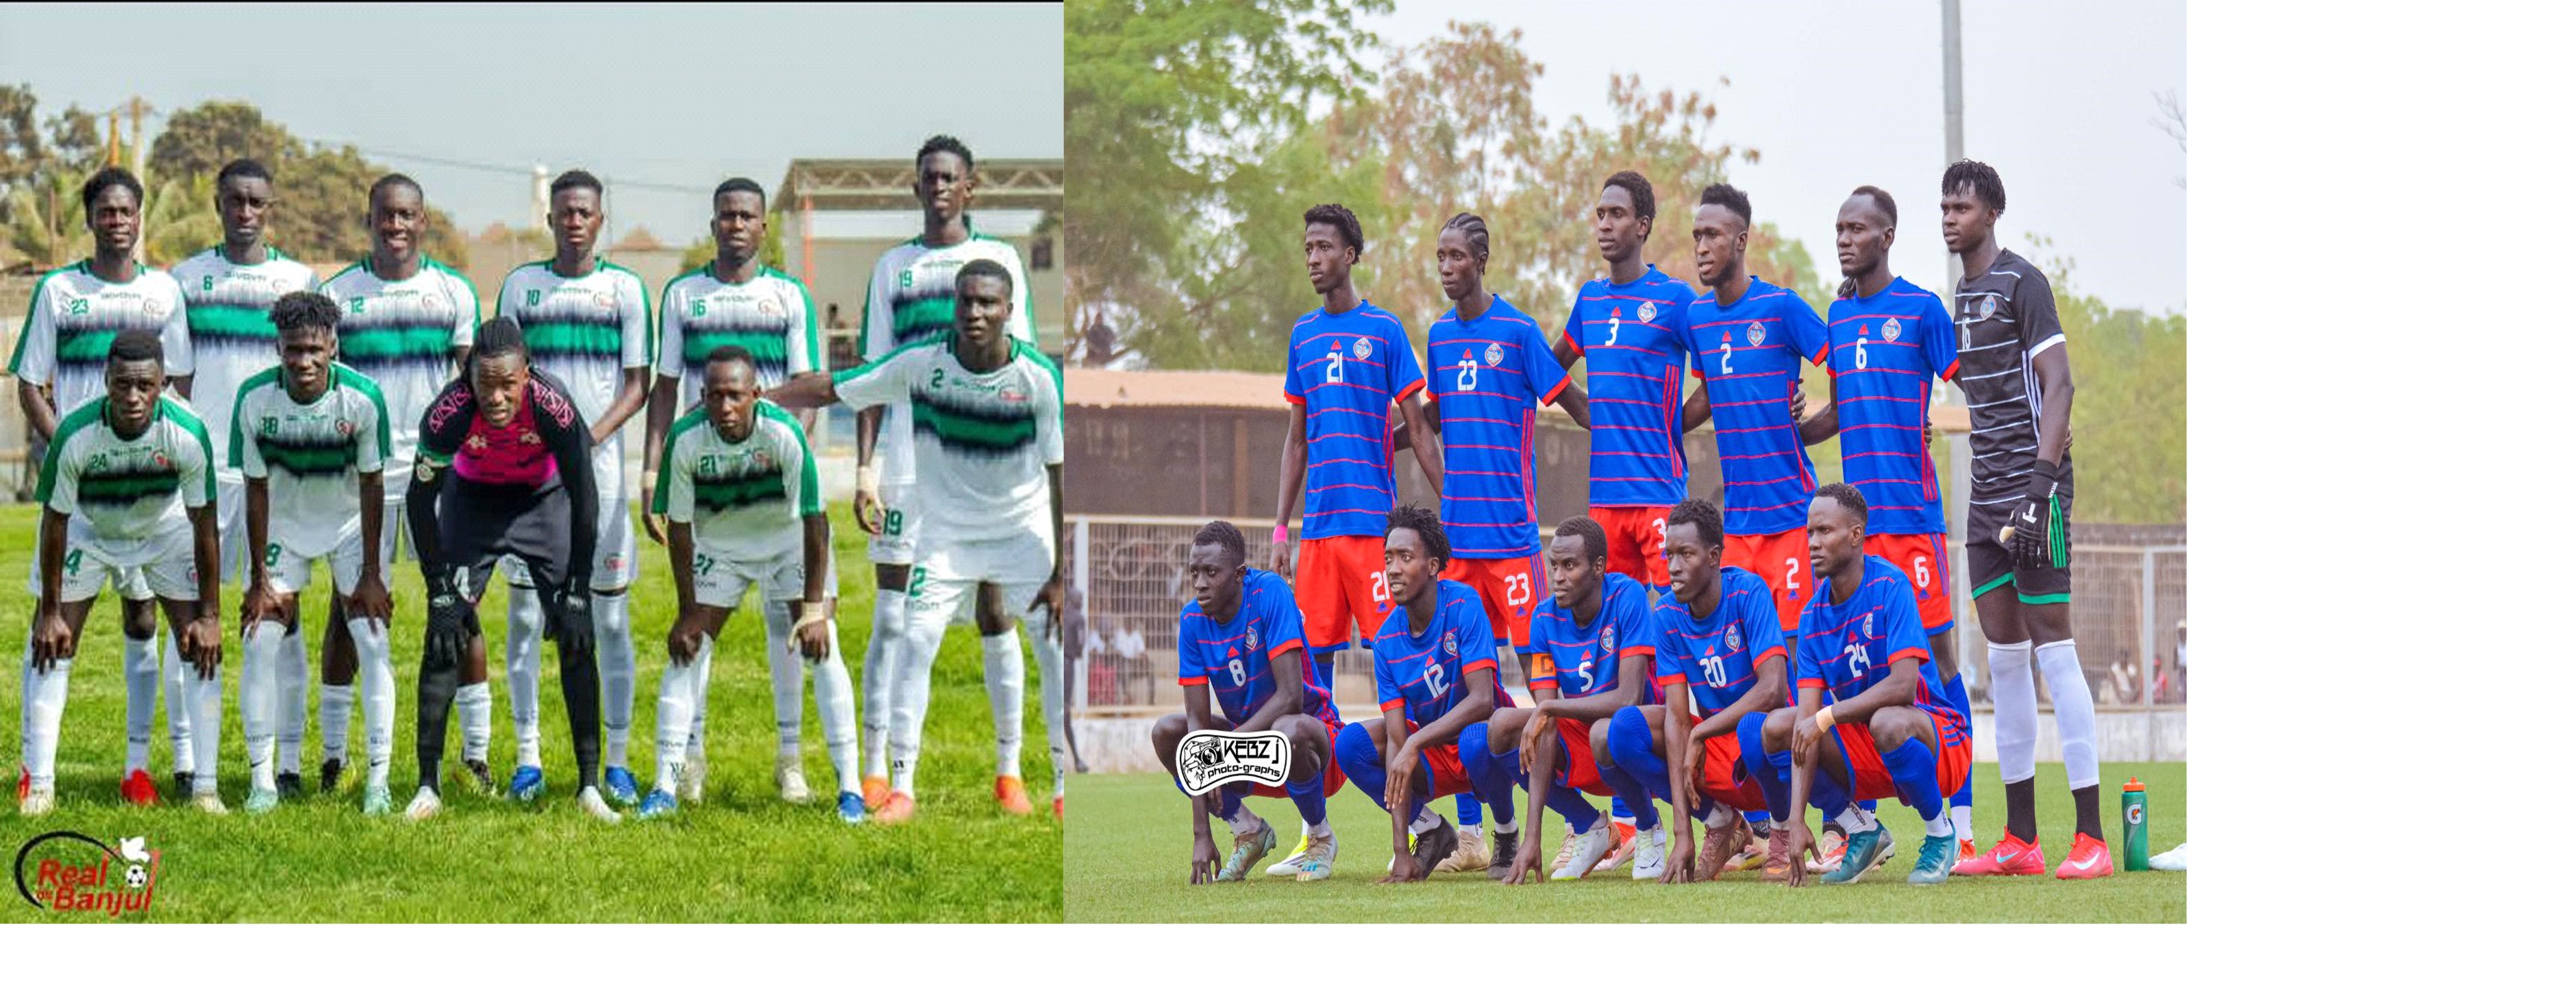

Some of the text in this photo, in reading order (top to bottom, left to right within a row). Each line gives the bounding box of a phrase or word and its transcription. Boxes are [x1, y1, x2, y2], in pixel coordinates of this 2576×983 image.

[203, 276, 212, 290] 6
[899, 270, 912, 287] 19
[72, 299, 88, 314] 23
[350, 297, 364, 312] 12
[527, 290, 540, 306] 10
[692, 300, 706, 316] 16
[1605, 317, 1620, 346] 3
[1326, 351, 1343, 384] 21
[1720, 343, 1733, 374] 2
[1855, 338, 1868, 370] 6
[931, 367, 944, 388] 2
[1457, 360, 1477, 391] 23
[699, 455, 716, 473] 21
[883, 508, 902, 536] 19
[1652, 517, 1667, 549] 3
[909, 567, 926, 597] 2
[1370, 570, 1390, 603] 21
[1785, 558, 1799, 590] 2
[1914, 556, 1930, 588] 6
[1504, 572, 1531, 606] 23
[1228, 659, 1246, 687] 8
[1540, 654, 1553, 673] C
[1699, 655, 1727, 688] 20
[1844, 642, 1871, 679] 24
[1423, 663, 1450, 699] 12
[1578, 661, 1594, 693] 5
